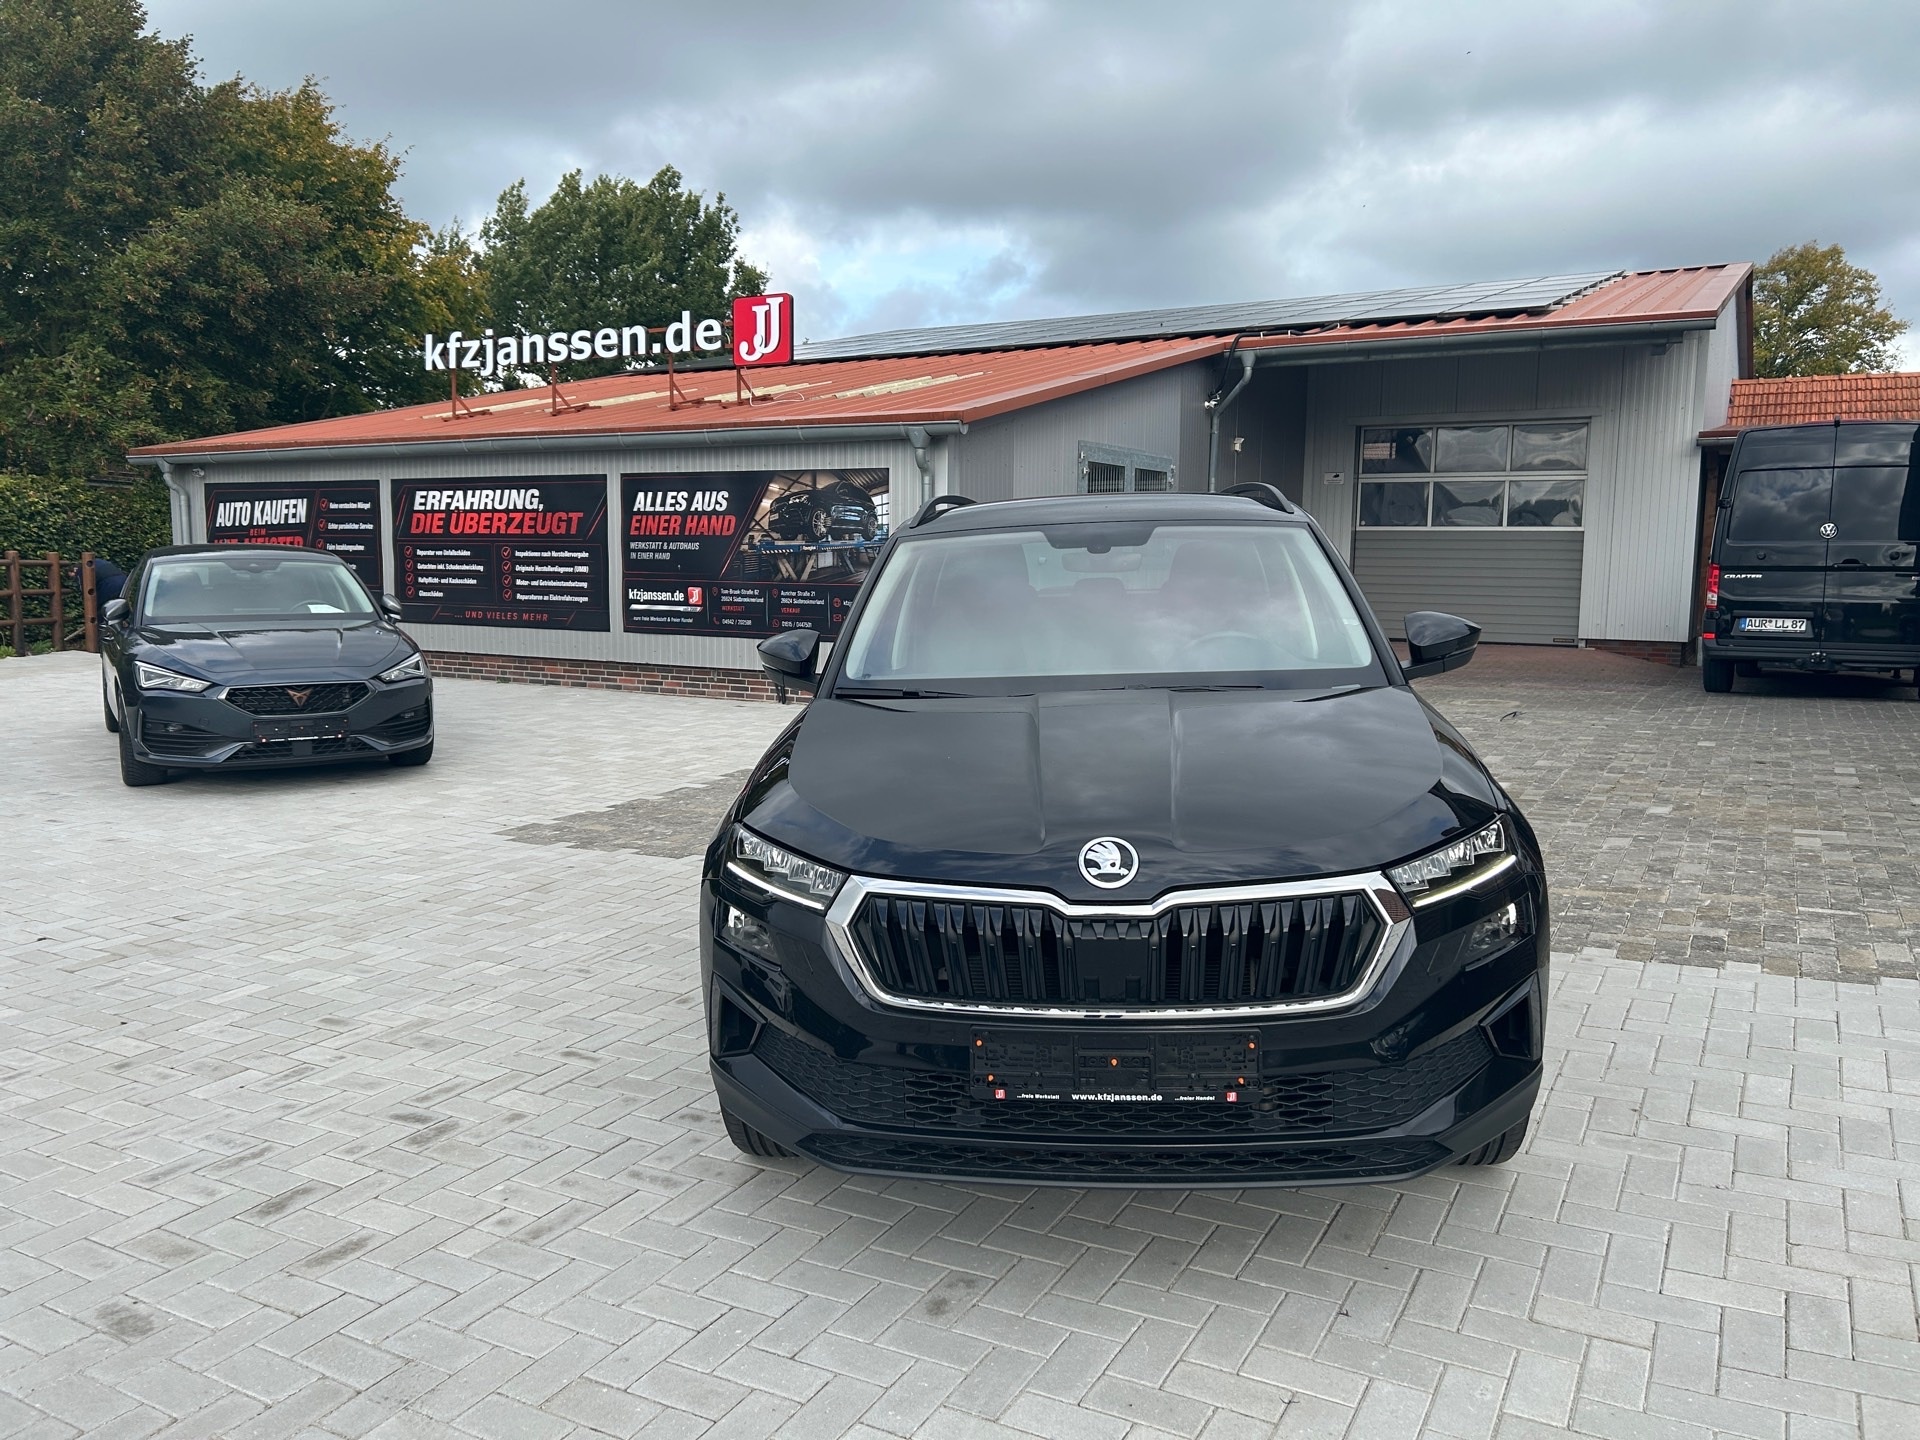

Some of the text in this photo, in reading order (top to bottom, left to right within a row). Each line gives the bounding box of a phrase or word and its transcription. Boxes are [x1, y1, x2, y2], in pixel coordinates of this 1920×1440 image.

[424, 310, 722, 377] kfzjanssen.de
[413, 489, 544, 512] ERFAHRUNG,
[633, 491, 729, 512] ALLES AUS
[216, 499, 308, 527] AUTO KAUFEN
[410, 509, 584, 535] DIE ÜBERZEUGT
[630, 514, 736, 536] EINER HAND
[249, 528, 267, 536] BEIM
[629, 541, 700, 550] WERKSTATT & AUTOHAUS
[630, 552, 670, 560] IN EINER HAND
[515, 564, 535, 573] Originale
[515, 578, 530, 586] Motor-
[628, 588, 685, 602] kfzjanssen.de
[465, 611, 483, 619] UND
[486, 611, 519, 620] VIELES
[522, 613, 549, 622] MEHR
[1746, 619, 1805, 629] AUR LL 87
[1071, 1092, 1163, 1102] www.kfzjanssen.de
